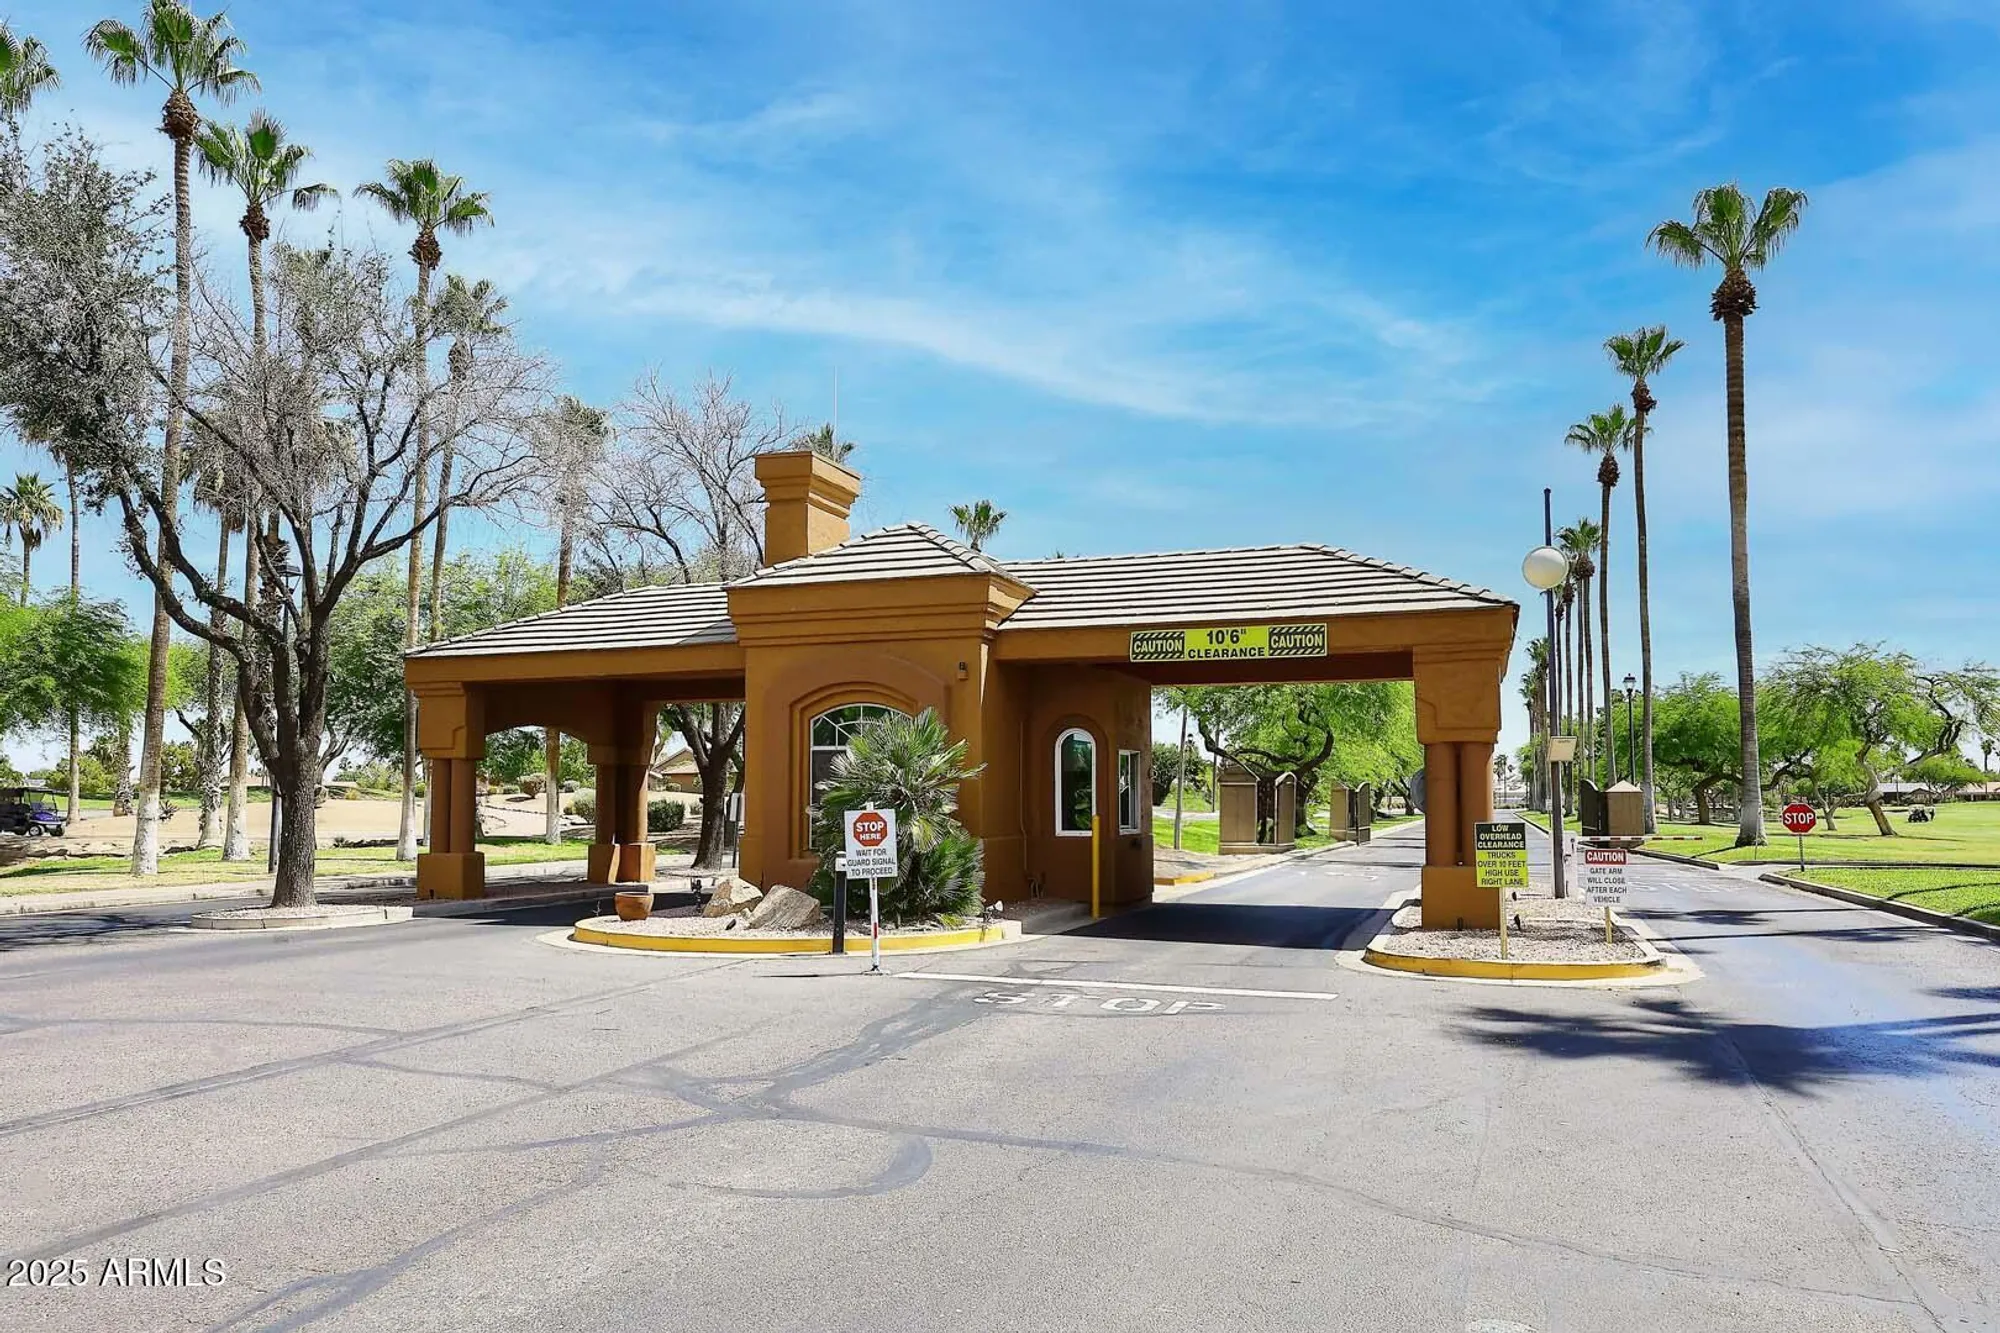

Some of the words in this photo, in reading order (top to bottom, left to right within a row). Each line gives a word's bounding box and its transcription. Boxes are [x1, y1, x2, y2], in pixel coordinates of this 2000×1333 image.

[1206, 628, 1246, 645] 10'6"
[1270, 633, 1323, 649] CAUTION
[1133, 638, 1183, 653] CAUTION
[1188, 646, 1265, 659] CLEARANCE
[1784, 812, 1814, 824] STOP
[856, 821, 884, 832] STOP
[1491, 824, 1509, 832] LOW
[856, 849, 872, 857] WAIT
[873, 848, 887, 856] FOR
[1487, 851, 1516, 859] TRUCKS
[1586, 851, 1624, 862] CAUTION
[847, 859, 871, 867] GUARD
[871, 857, 896, 866] SIGNAL
[851, 868, 860, 877] TO
[862, 867, 893, 876] PROCEED
[974, 991, 1226, 1015] STOP
